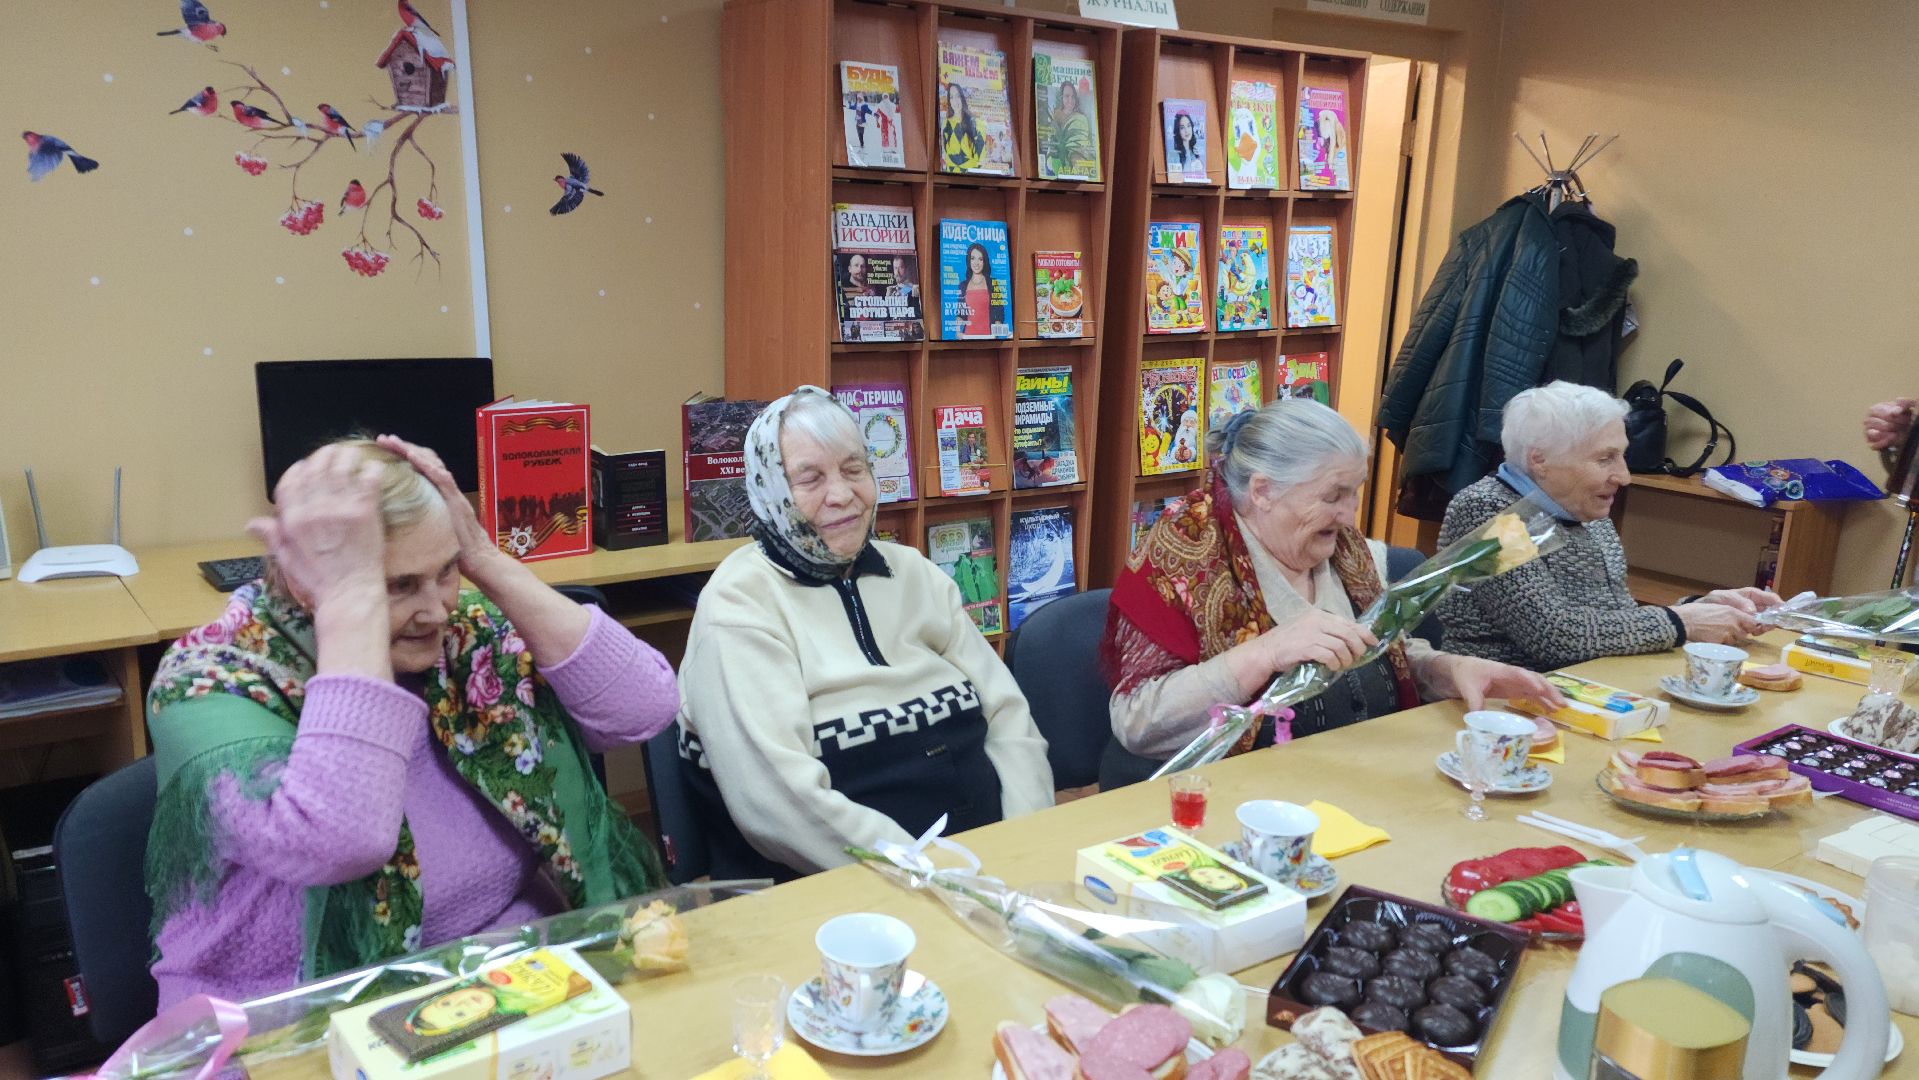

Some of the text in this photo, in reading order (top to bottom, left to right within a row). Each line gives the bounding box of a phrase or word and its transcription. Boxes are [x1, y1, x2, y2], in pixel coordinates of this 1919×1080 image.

[1086, 0, 1168, 15] ЖУРНАЛЫ
[841, 212, 909, 230] ЗАГАДКИ
[842, 228, 911, 244] ИСТОРИИ
[943, 224, 1006, 243] КУДЕСНИЦА
[1151, 226, 1197, 249] ЁЖИК
[854, 295, 908, 307] СТОЛЫПИН
[849, 306, 915, 320] ПРОТИВ ЦАРЯ
[1016, 375, 1068, 391] Тайны
[941, 407, 983, 429] Дача
[707, 456, 745, 465] Волокол
